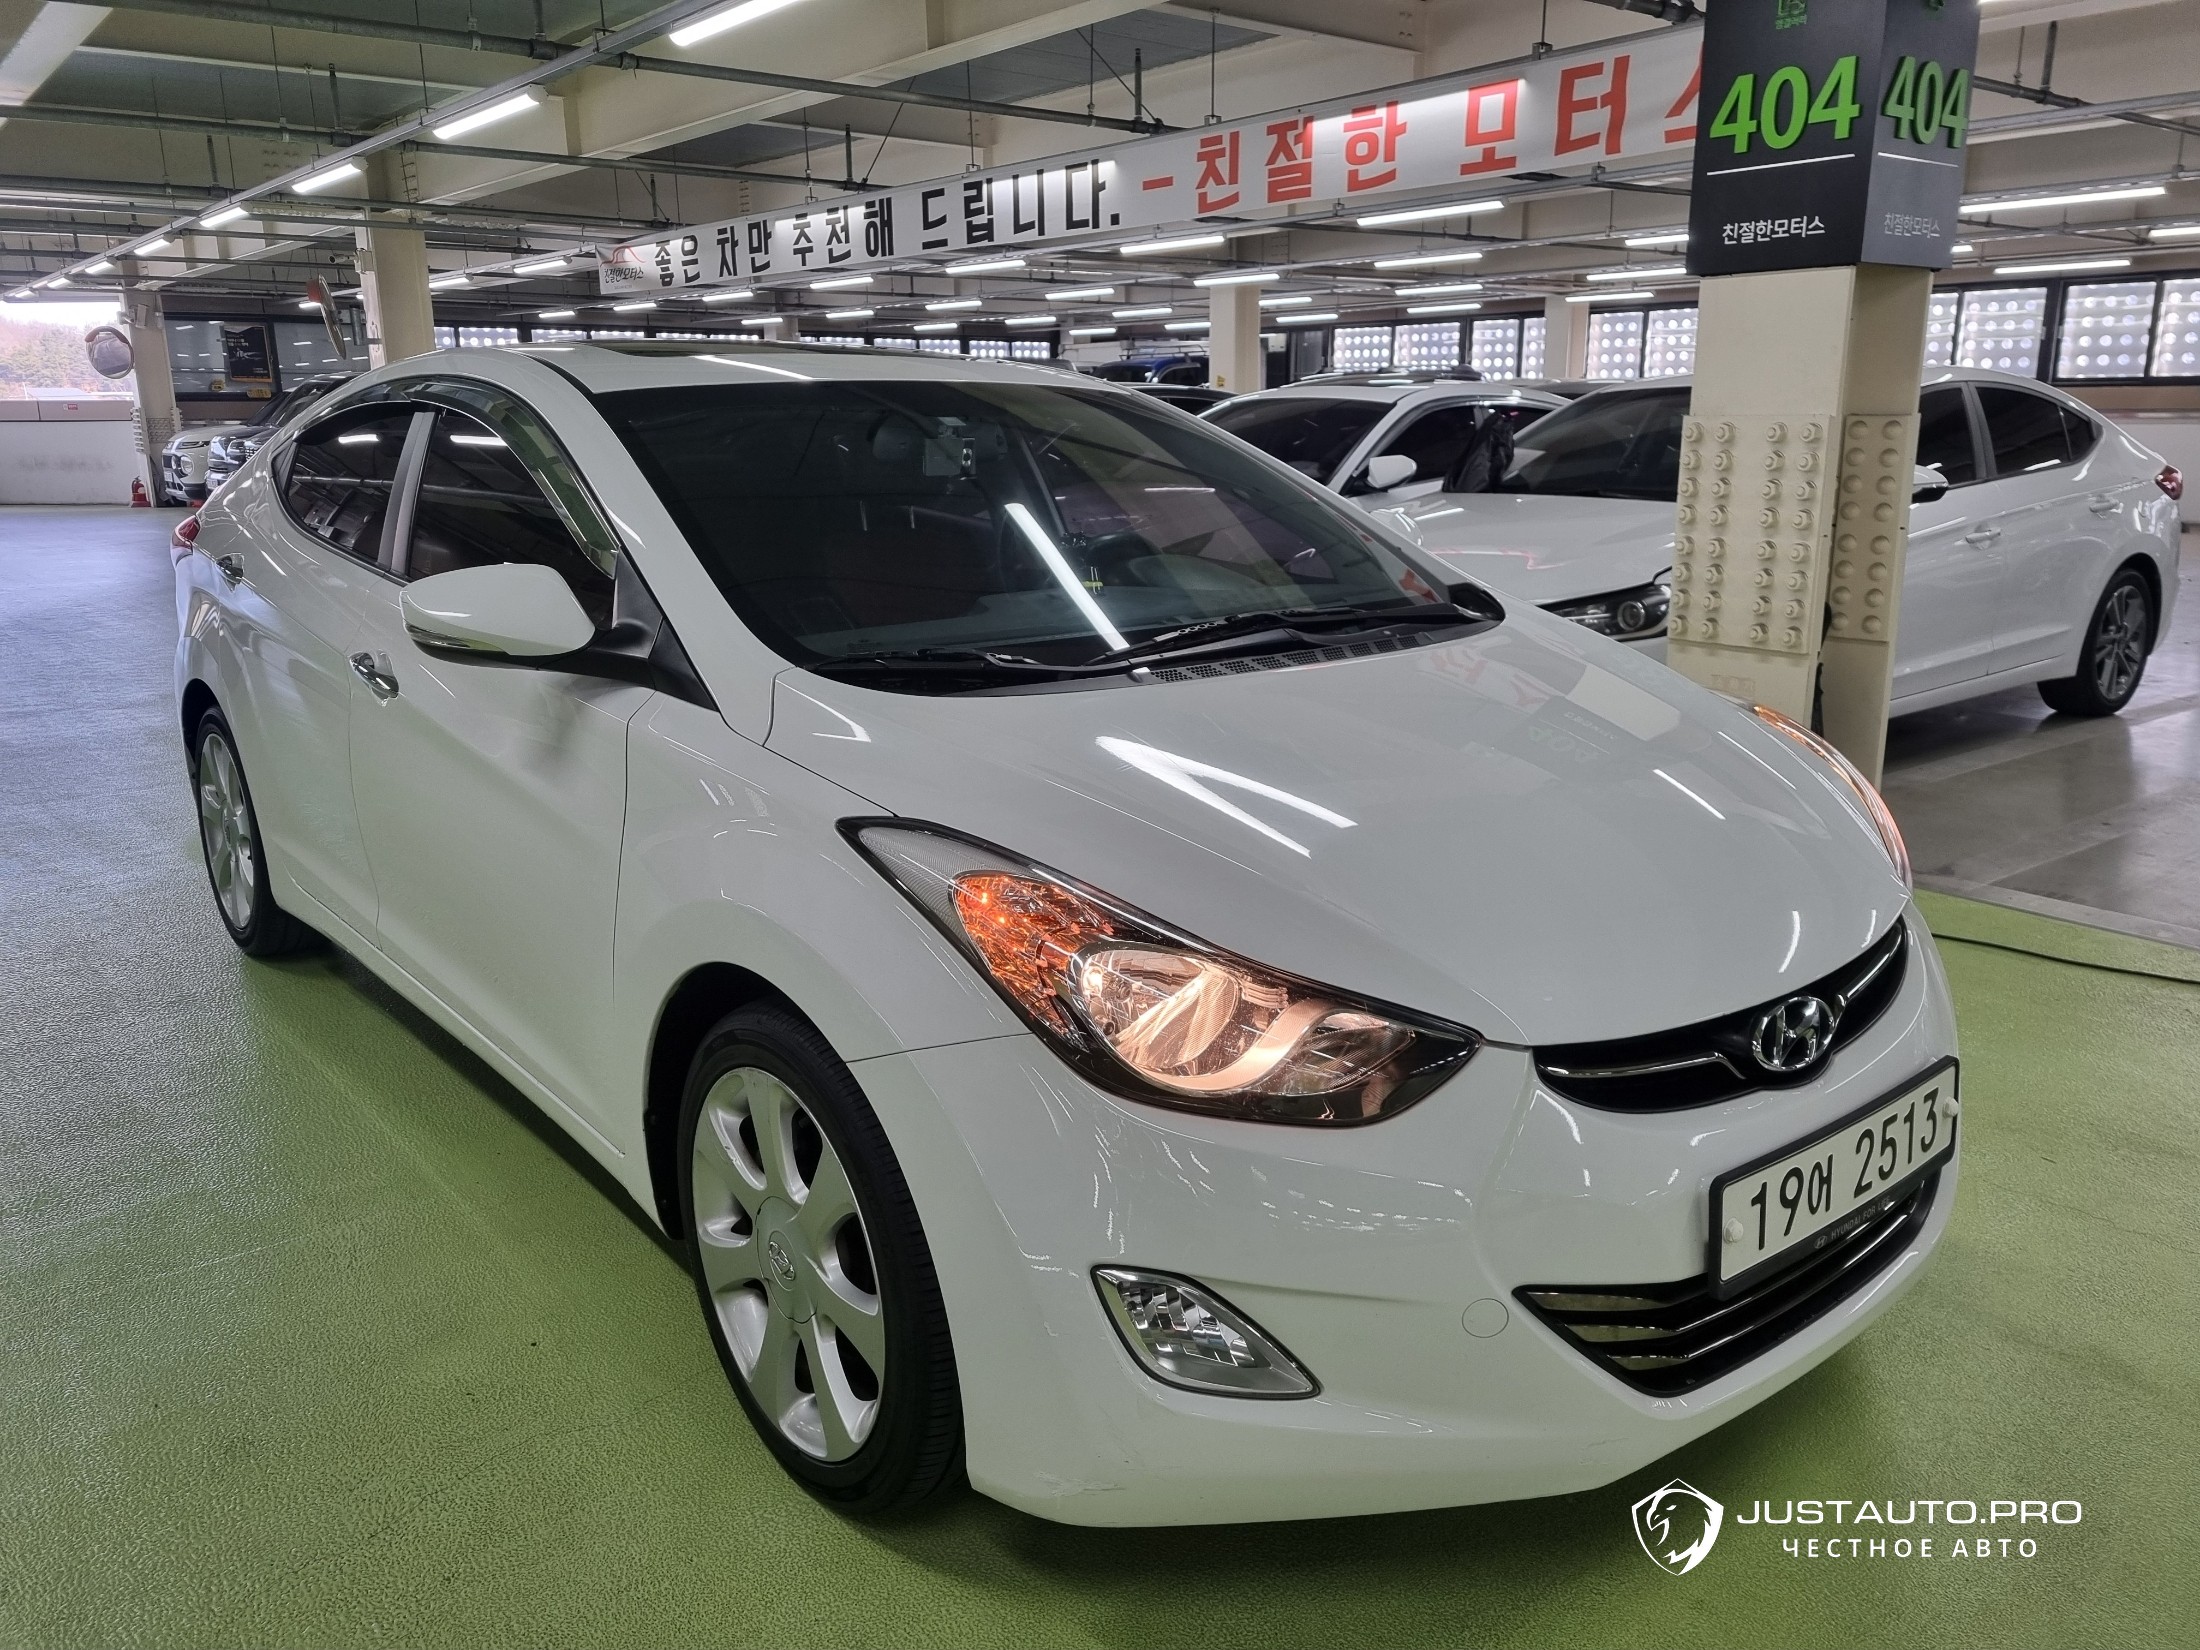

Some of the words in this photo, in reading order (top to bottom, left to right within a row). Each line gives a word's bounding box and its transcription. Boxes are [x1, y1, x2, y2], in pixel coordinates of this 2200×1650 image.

[1709, 55, 1861, 154] 404
[1884, 55, 1970, 148] 404
[655, 235, 700, 287] 좋은
[717, 219, 772, 277] 차만
[793, 196, 894, 266] 추천해
[922, 159, 1120, 250] 드립니다.
[1195, 101, 1408, 214] 친절한
[1722, 215, 1826, 245] 친절한모터스
[1884, 211, 1941, 239] 친절한모터스
[1751, 1154, 1834, 1251] 19어
[1854, 1087, 1940, 1199] 2513
